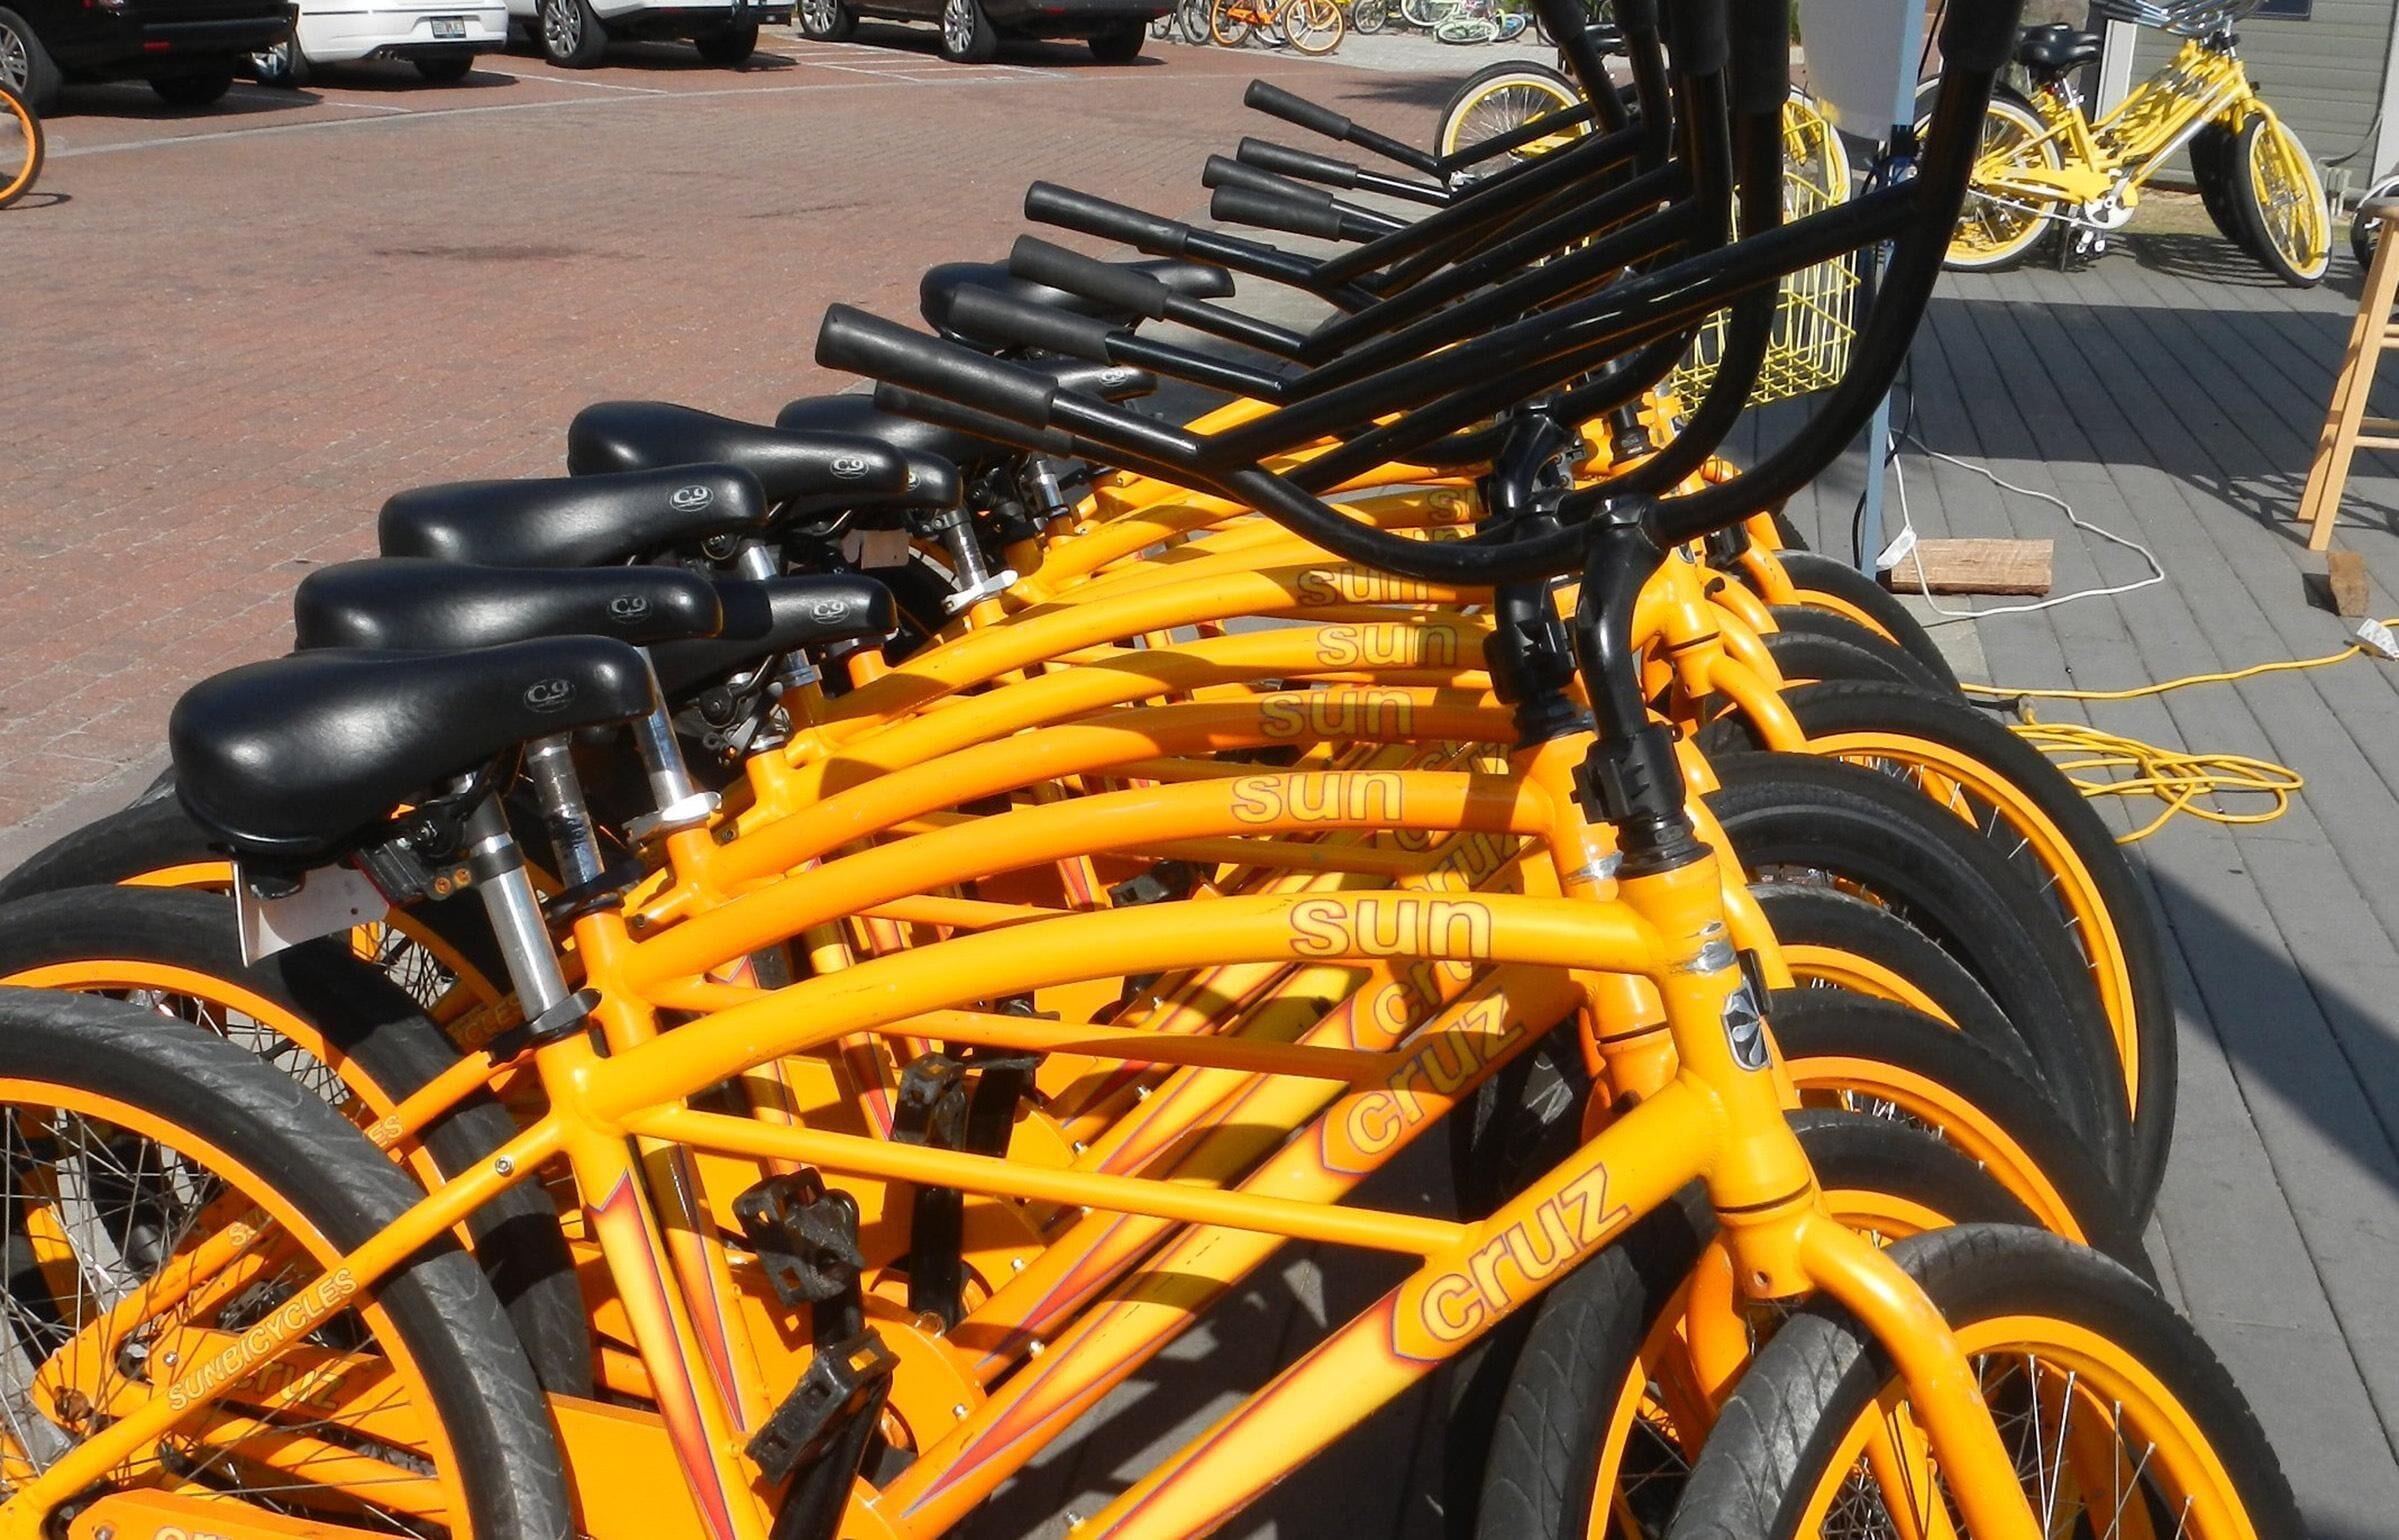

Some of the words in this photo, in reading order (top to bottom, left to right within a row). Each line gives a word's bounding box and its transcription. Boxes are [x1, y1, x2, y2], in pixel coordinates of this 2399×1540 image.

[832, 458, 864, 473] C9
[673, 486, 708, 504] C9
[611, 597, 647, 614] C9
[813, 601, 844, 617] C9
[1316, 624, 1458, 666] sun
[528, 679, 569, 703] C9
[1259, 689, 1414, 738] sun
[1231, 770, 1403, 824] sun
[1289, 898, 1492, 959] sun
[1347, 989, 1527, 1156] cruz
[1420, 1161, 1634, 1343] cruz
[168, 1268, 358, 1410] SUNBICYCLES
